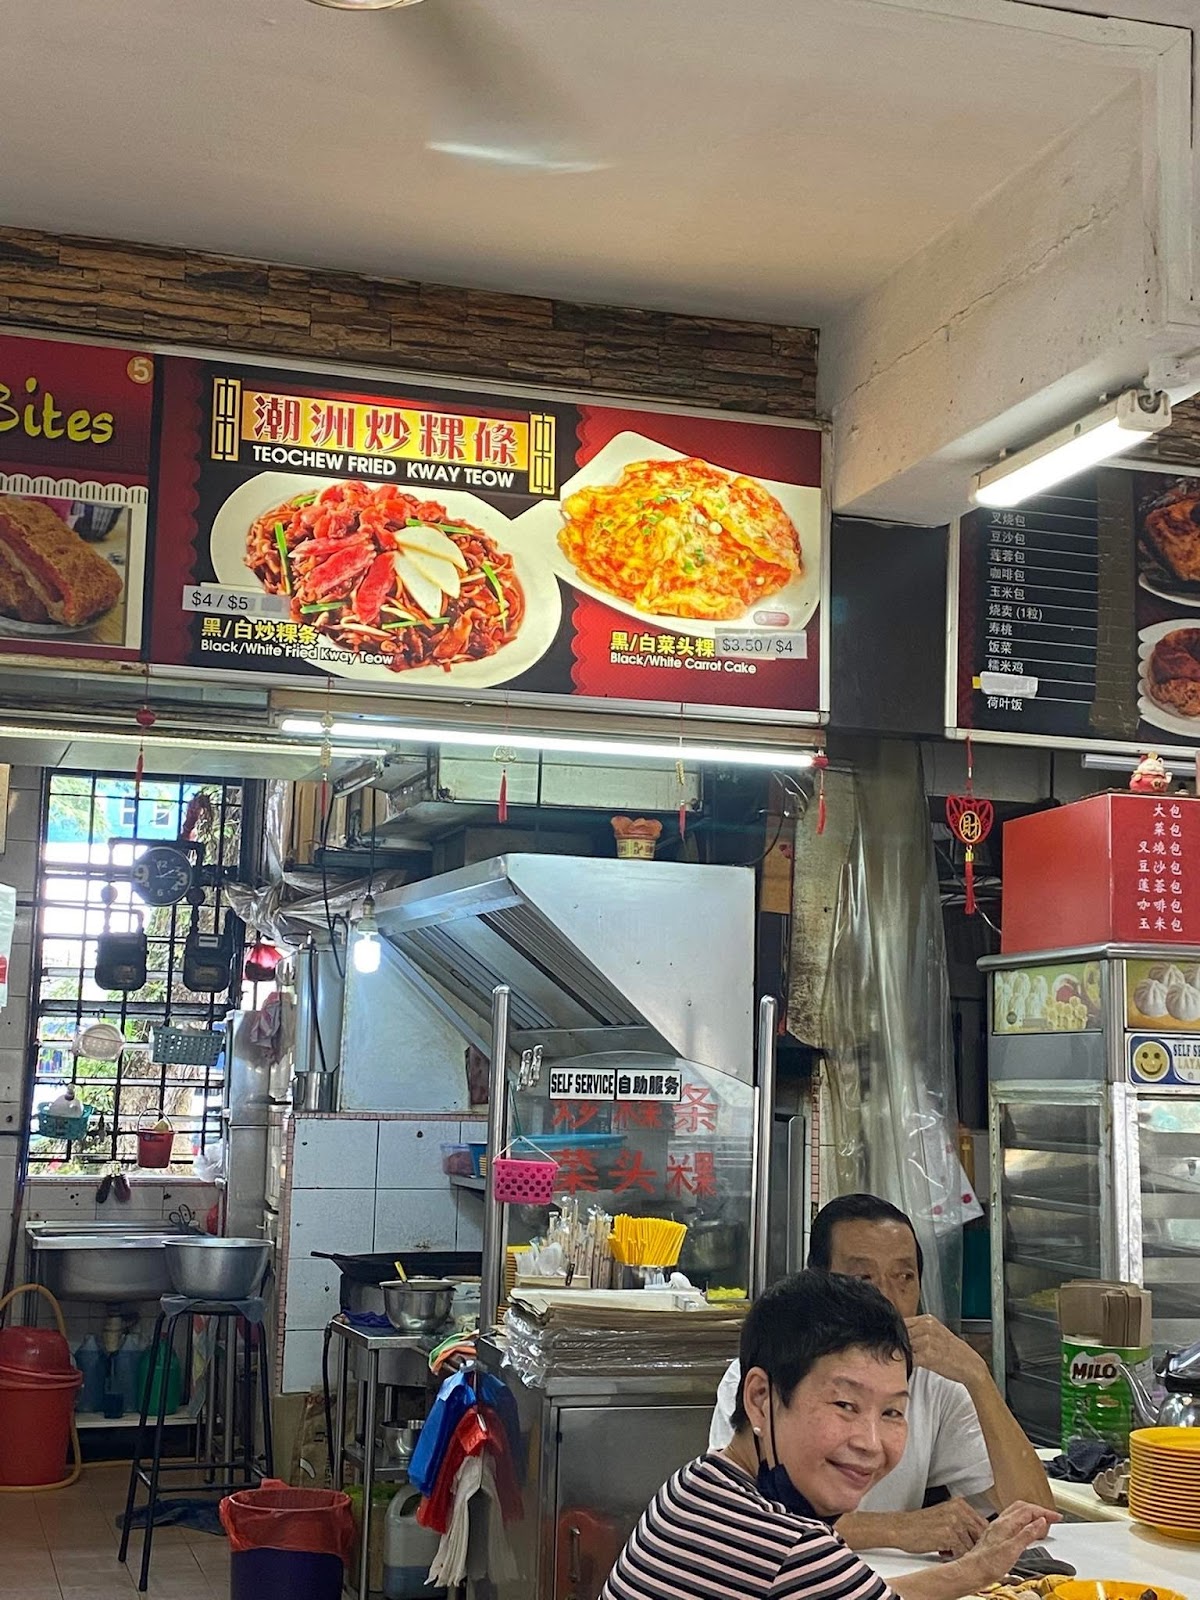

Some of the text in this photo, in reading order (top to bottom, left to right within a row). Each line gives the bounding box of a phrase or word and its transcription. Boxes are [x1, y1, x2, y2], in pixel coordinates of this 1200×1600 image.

[133, 359, 149, 381] 5
[254, 395, 517, 465] 潮洲炒粿條
[253, 446, 514, 488] TEOCHEW FRIED KWAY TEOW
[990, 530, 1025, 545] 豆沙包
[989, 566, 1025, 582] 咖啡包
[191, 590, 213, 607] $4
[227, 595, 249, 610] $5
[989, 585, 1025, 601] 玉米包
[201, 617, 319, 645] 黑/白炒粿条
[200, 639, 394, 665] Black/White Fried Kway Teow
[610, 631, 715, 658] 黑/白菜头粿
[722, 638, 763, 653] $3.50
[775, 641, 793, 654] $4
[610, 652, 757, 675] Black/White Carrot Cake
[987, 696, 1022, 711] 荷叶饭
[1153, 803, 1182, 818] 大包
[1153, 821, 1182, 837] 菜包
[1138, 859, 1182, 875] 豆沙包
[1139, 916, 1183, 932] 玉米包
[1173, 1044, 1191, 1057] SELF
[551, 1073, 614, 1094] SELF SERVICE
[618, 1075, 680, 1095] 自助服务
[1072, 1363, 1117, 1380] MILO
